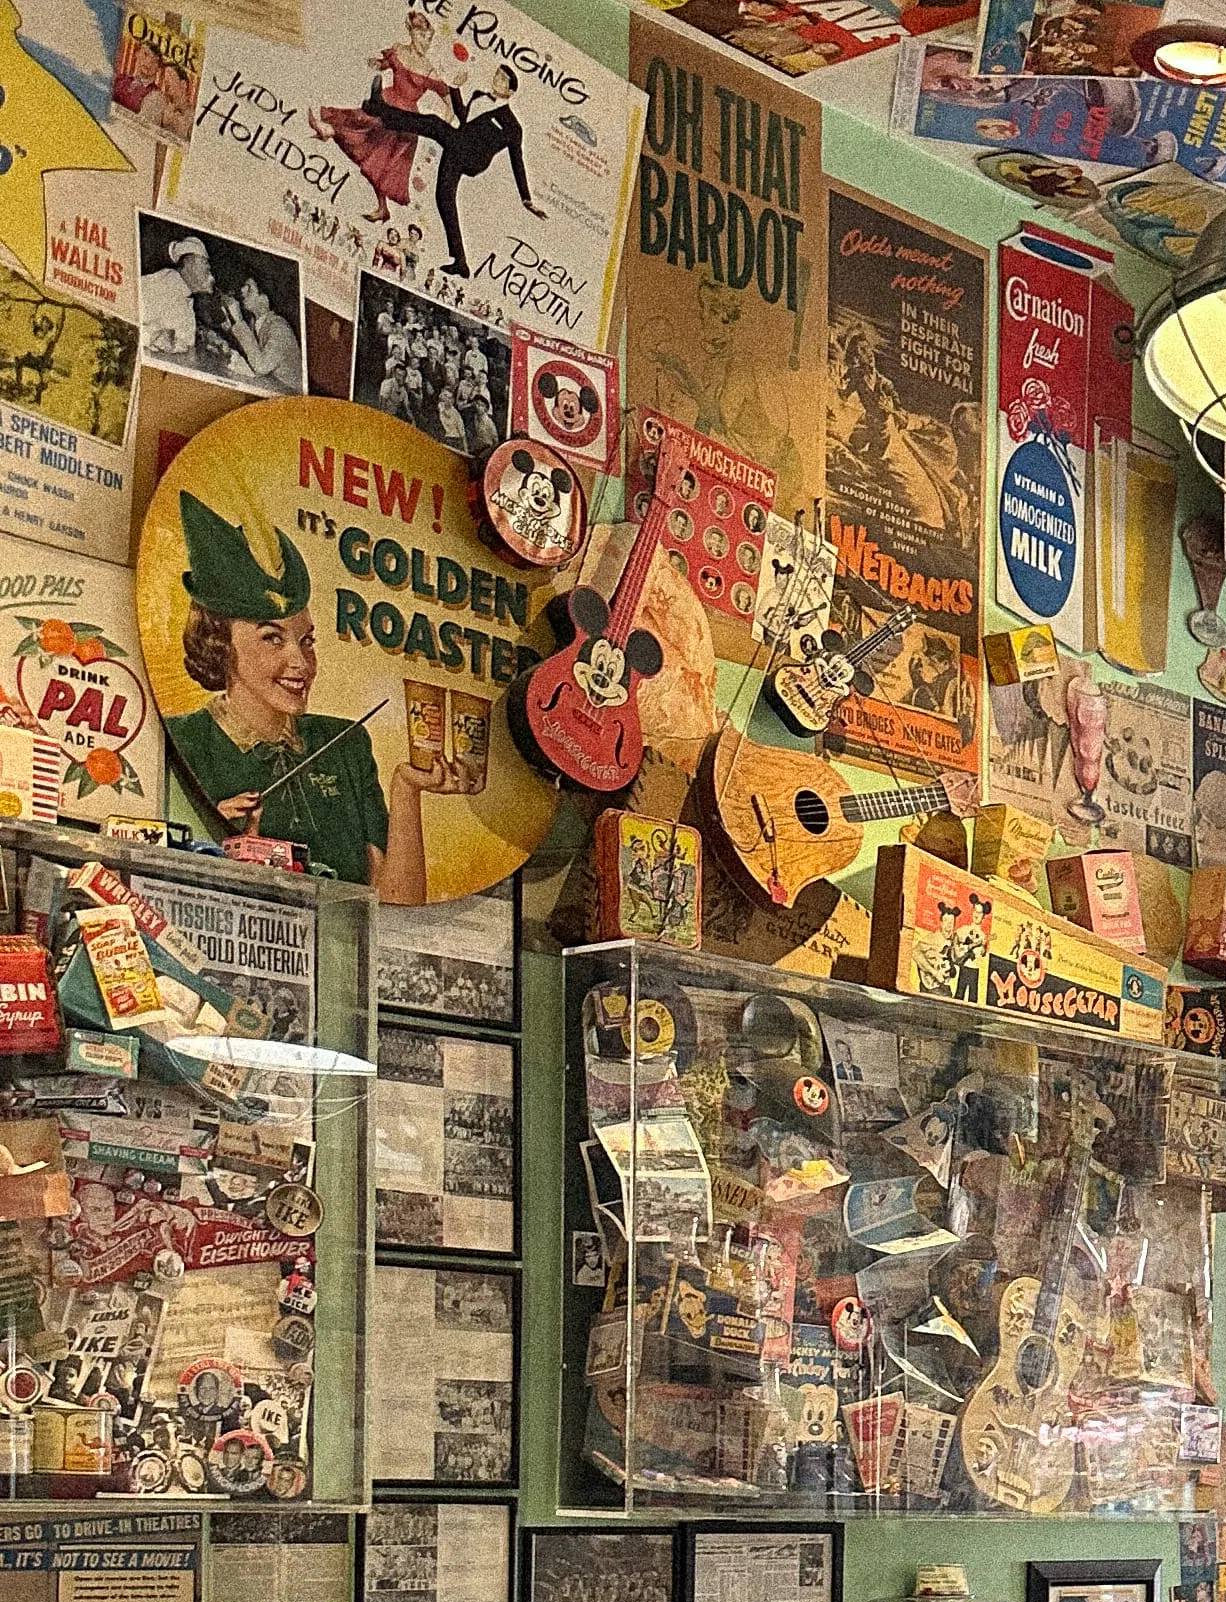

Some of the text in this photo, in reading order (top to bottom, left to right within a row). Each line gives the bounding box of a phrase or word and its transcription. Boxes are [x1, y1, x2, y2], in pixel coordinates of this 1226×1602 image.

[127, 12, 198, 73] Quick
[456, 5, 590, 104] RINGING
[646, 55, 703, 174] OH
[714, 85, 806, 213] THAT
[1183, 90, 1219, 149] LEWIS
[74, 215, 112, 251] HAL
[840, 228, 954, 273] Odds meant
[51, 237, 124, 286] WALLIS
[506, 235, 588, 295] DEAN
[53, 269, 117, 303] PRODUCTION
[473, 252, 584, 330] MARTIN
[891, 273, 965, 309] nothing
[901, 301, 960, 340] IN THEIR
[1005, 275, 1085, 339] Carnation
[900, 339, 971, 376] FIGHT FOR
[901, 321, 974, 361] DESPERATE
[1022, 327, 1060, 370] fresh
[11, 413, 78, 454] SPENCER
[40, 447, 123, 492] MIDDLETON
[690, 437, 775, 499] MOUSEKETEERS
[839, 484, 912, 516] EXPLOSIVE STORY
[1013, 472, 1066, 507] VITAMIN D
[297, 508, 337, 539] IT'S
[1004, 492, 1076, 546] HOMOGENIZED
[830, 513, 974, 617] WETBACKS
[1010, 526, 1064, 583] MILK
[39, 574, 86, 599] PALS
[338, 526, 530, 628] GOLDEN
[57, 664, 110, 687] DRINK
[37, 678, 129, 739] PAL
[63, 729, 96, 749] ADE
[855, 710, 896, 737] BRIDGES
[902, 723, 933, 748] NANCY
[934, 734, 962, 755] GATES
[111, 826, 140, 842] MILK
[98, 871, 164, 932] WRIGLEY
[170, 902, 309, 950] TISSUES ACTUALLY
[238, 945, 310, 977] BACTERIA!
[91, 1143, 178, 1168] SHAVING CREAM
[214, 1229, 268, 1245] DWIGHT
[274, 1204, 308, 1230] IKE
[199, 1242, 314, 1266] EISENHOWER
[76, 1335, 117, 1353] IKE
[261, 1407, 282, 1426] IKE
[24, 1514, 200, 1541] GO TO DRIVE-IN THEATRES
[15, 1550, 190, 1569] IT'S NOT TO SEE A MOVIE!
